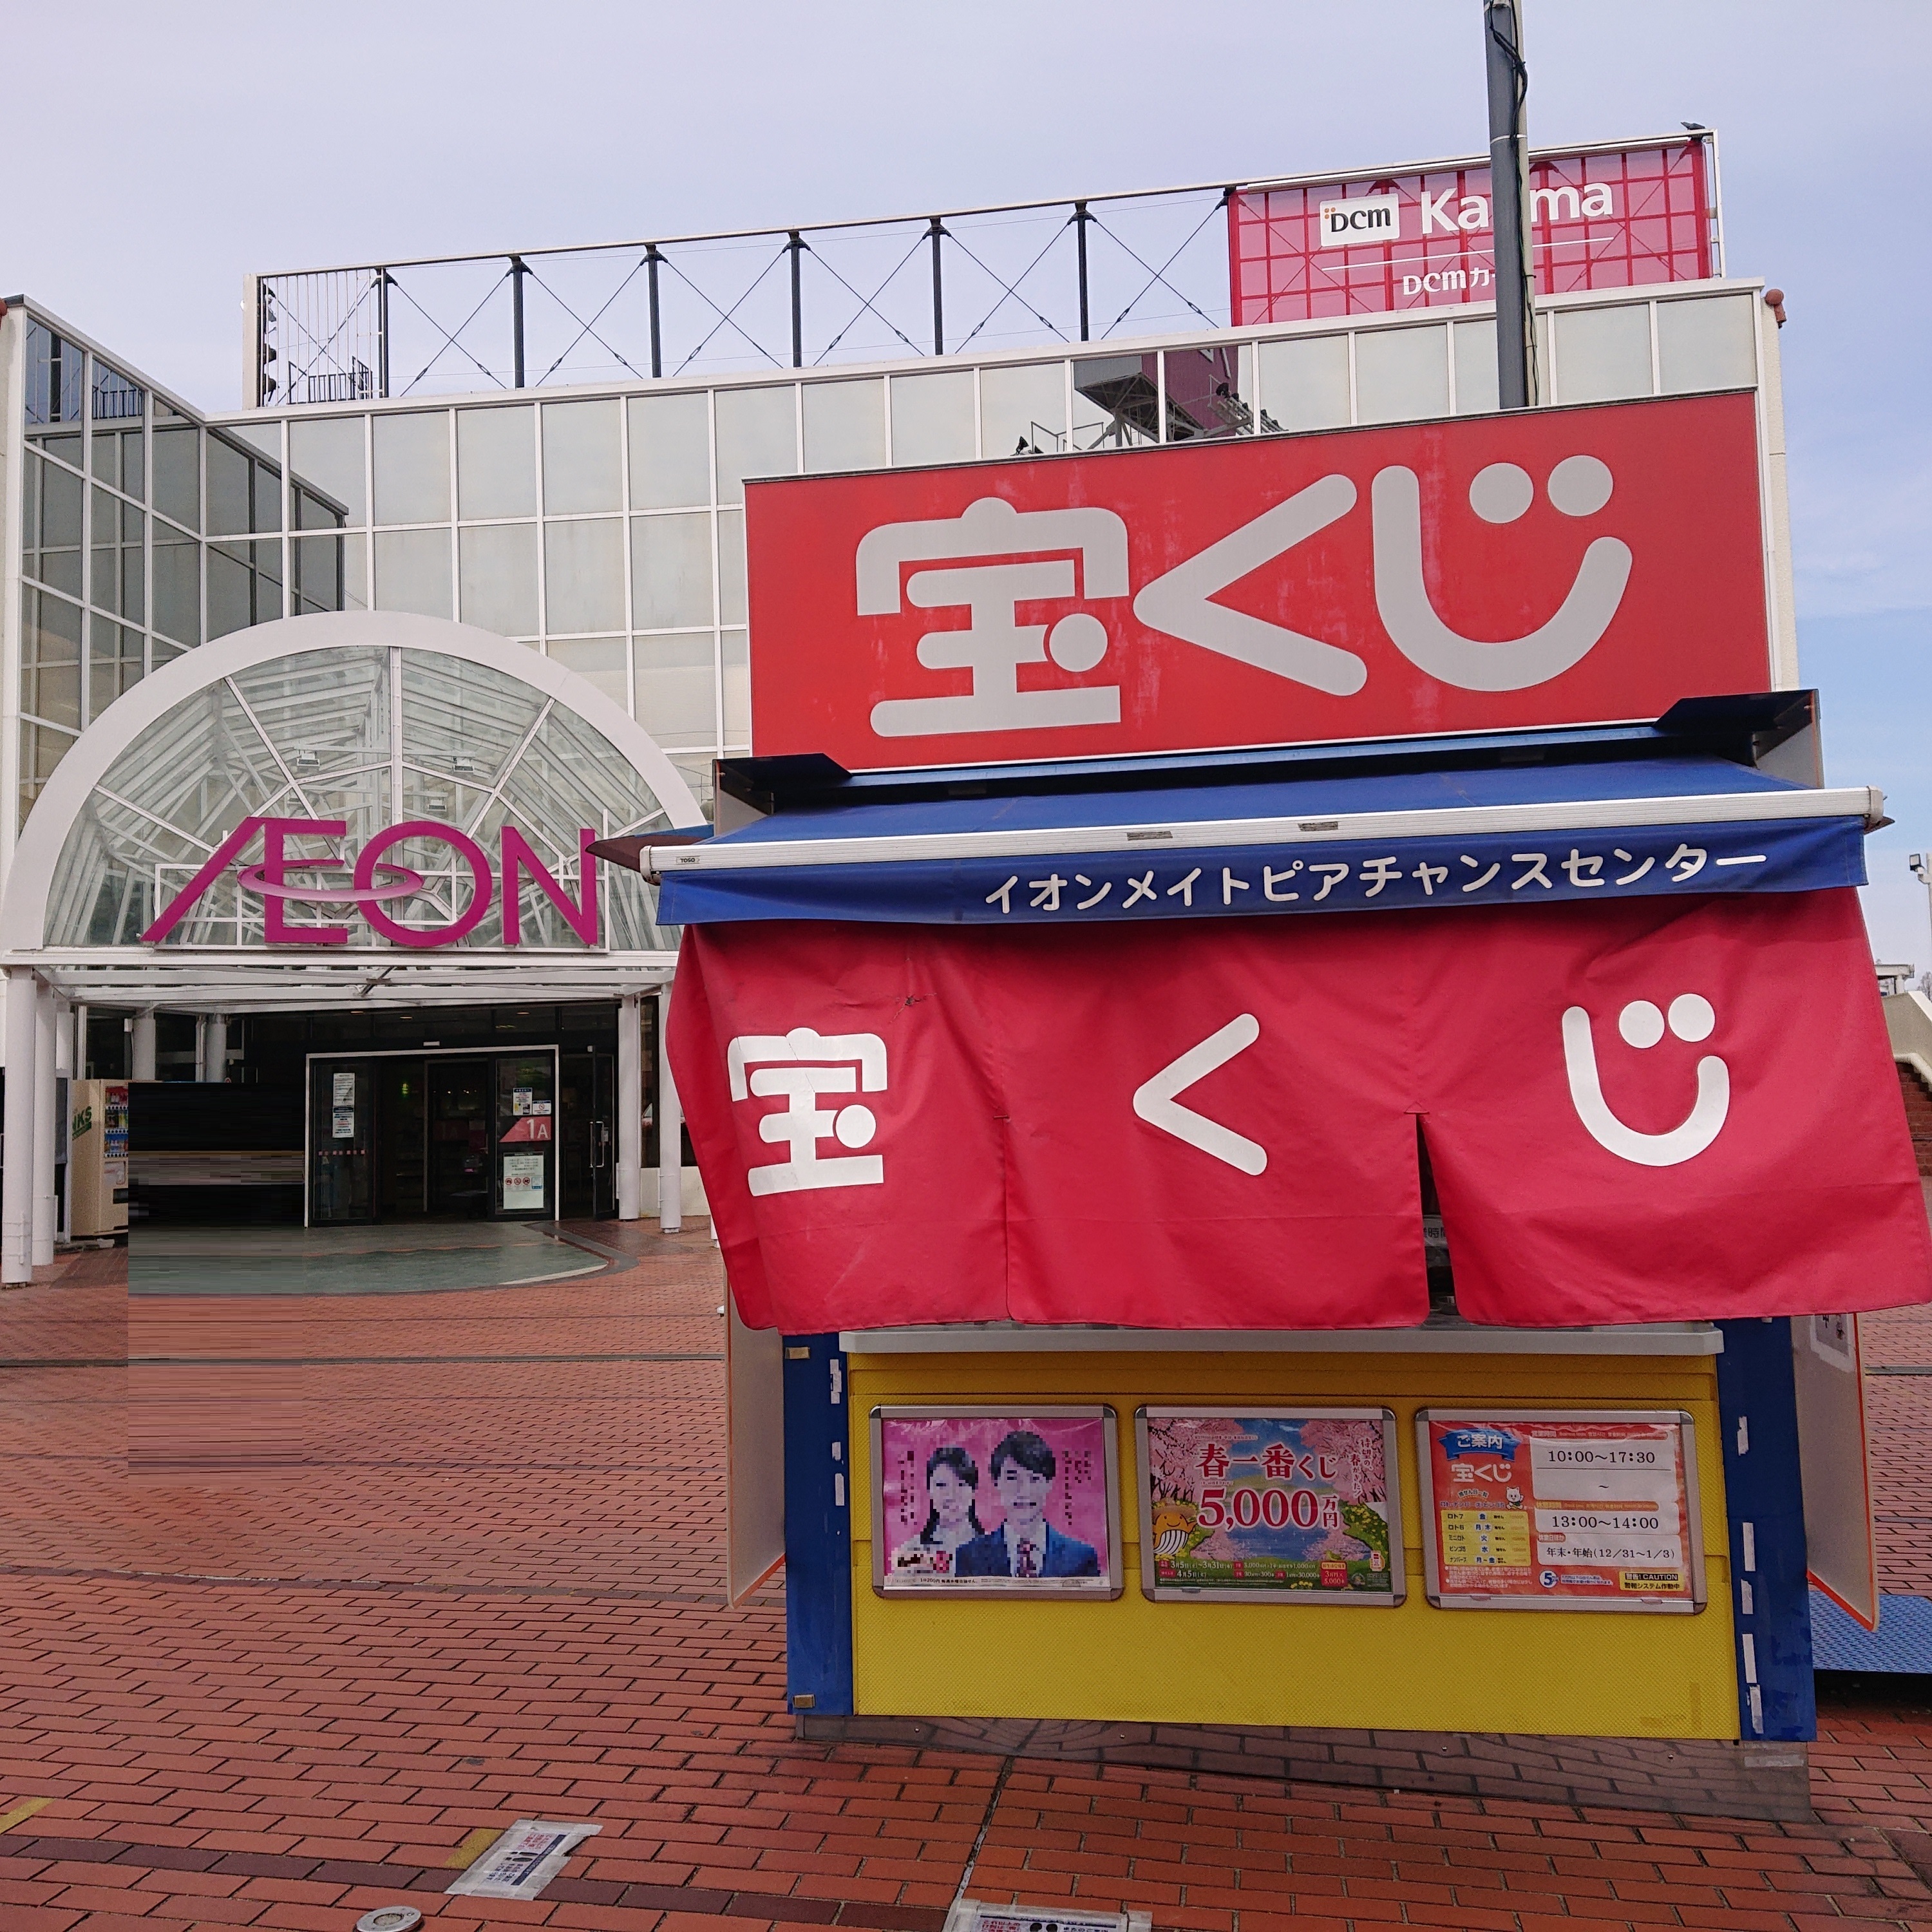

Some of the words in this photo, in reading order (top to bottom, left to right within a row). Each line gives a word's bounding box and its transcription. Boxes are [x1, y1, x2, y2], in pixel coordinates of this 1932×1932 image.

[1420, 183, 1613, 234] Kama
[855, 455, 1633, 737] 宝くじ
[986, 843, 1766, 914] イオンメイトピアチャンスセンター
[527, 1119, 548, 1139] 1A
[1457, 1434, 1503, 1450] ご案内
[1195, 1443, 1337, 1479] 春一番くじ
[1451, 1463, 1512, 1482] 宝くじ
[1624, 1582, 1680, 1590] 警報システム作動中
